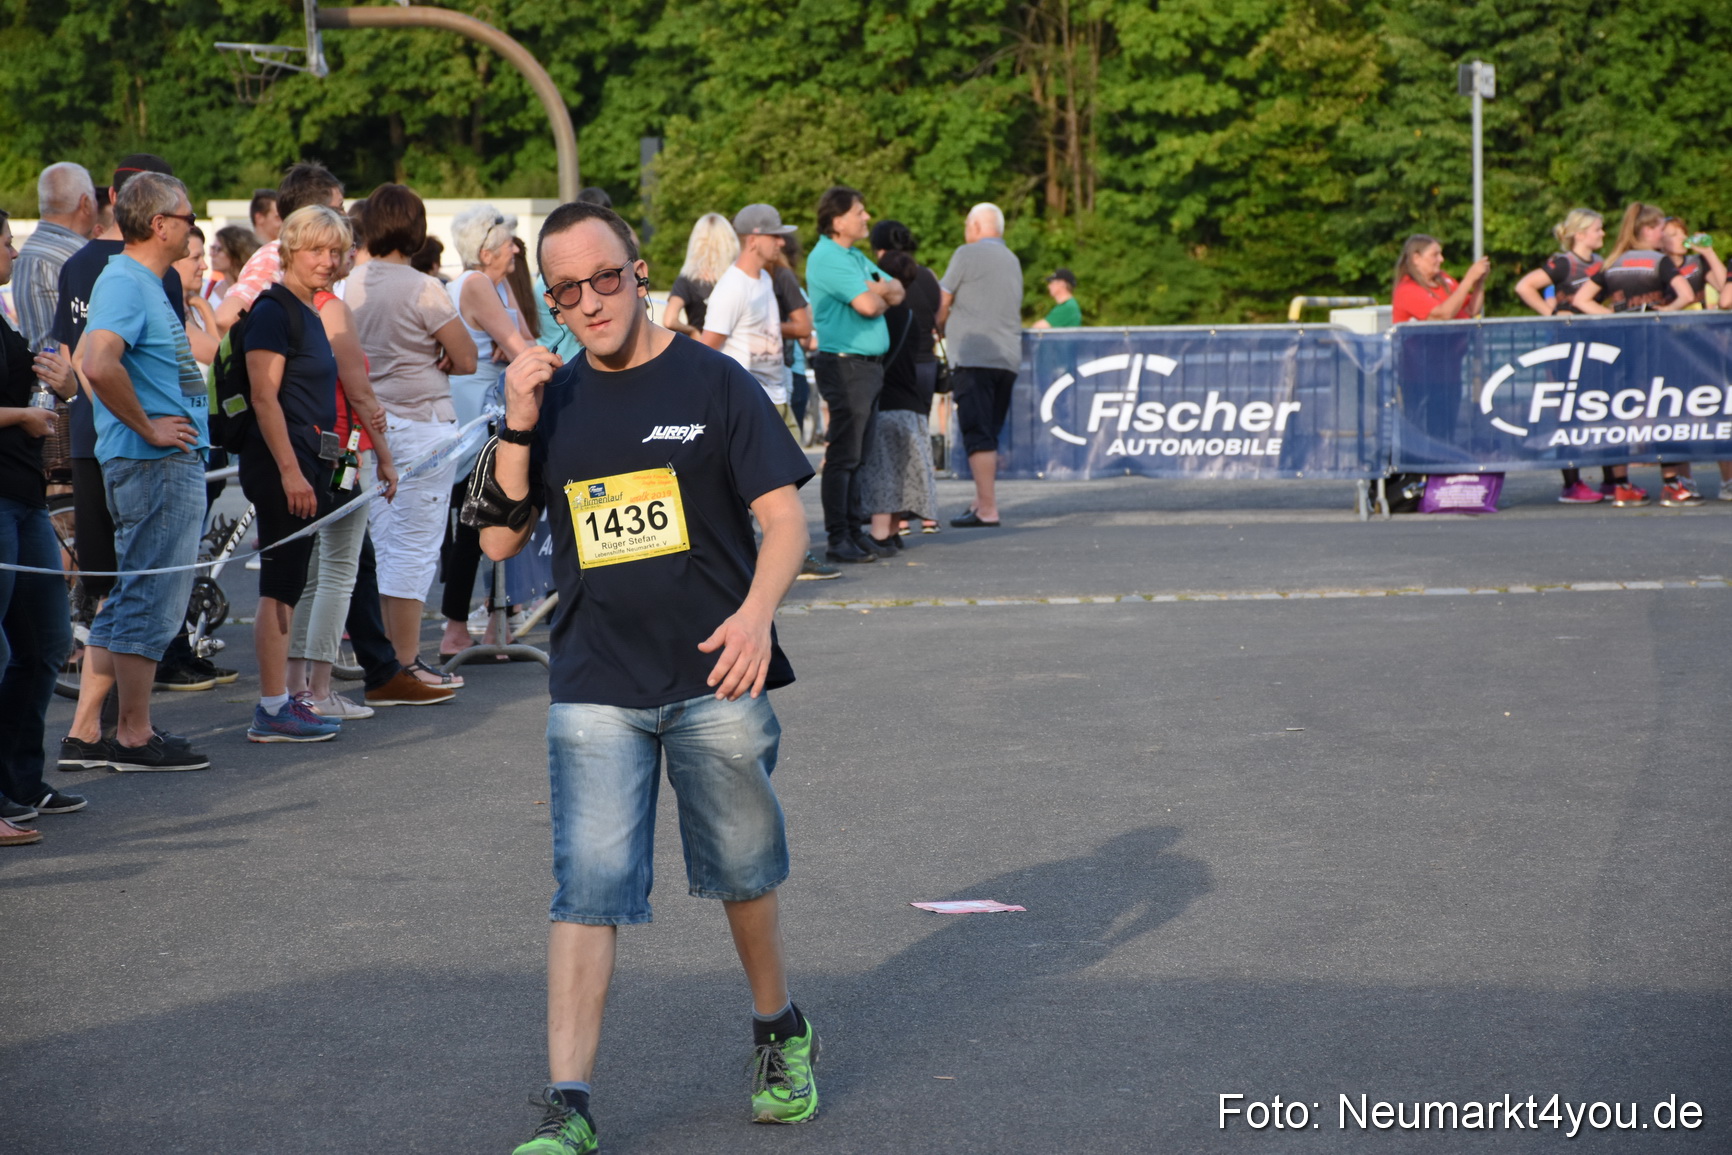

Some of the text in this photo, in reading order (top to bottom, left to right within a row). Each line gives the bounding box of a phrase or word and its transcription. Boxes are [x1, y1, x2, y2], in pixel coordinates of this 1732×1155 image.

[1087, 391, 1301, 432] Fischer
[642, 425, 690, 443] JURA
[1549, 422, 1732, 446] AUTOMOBILE
[1106, 438, 1283, 456] AUTOMOBILE
[584, 492, 623, 506] firmenlauf
[651, 490, 672, 500] 2019
[586, 500, 668, 542] 1436
[594, 548, 626, 558] Lebenshilfe
[626, 543, 654, 552] Neumarkt
[602, 534, 656, 550] Rüger Stefan
